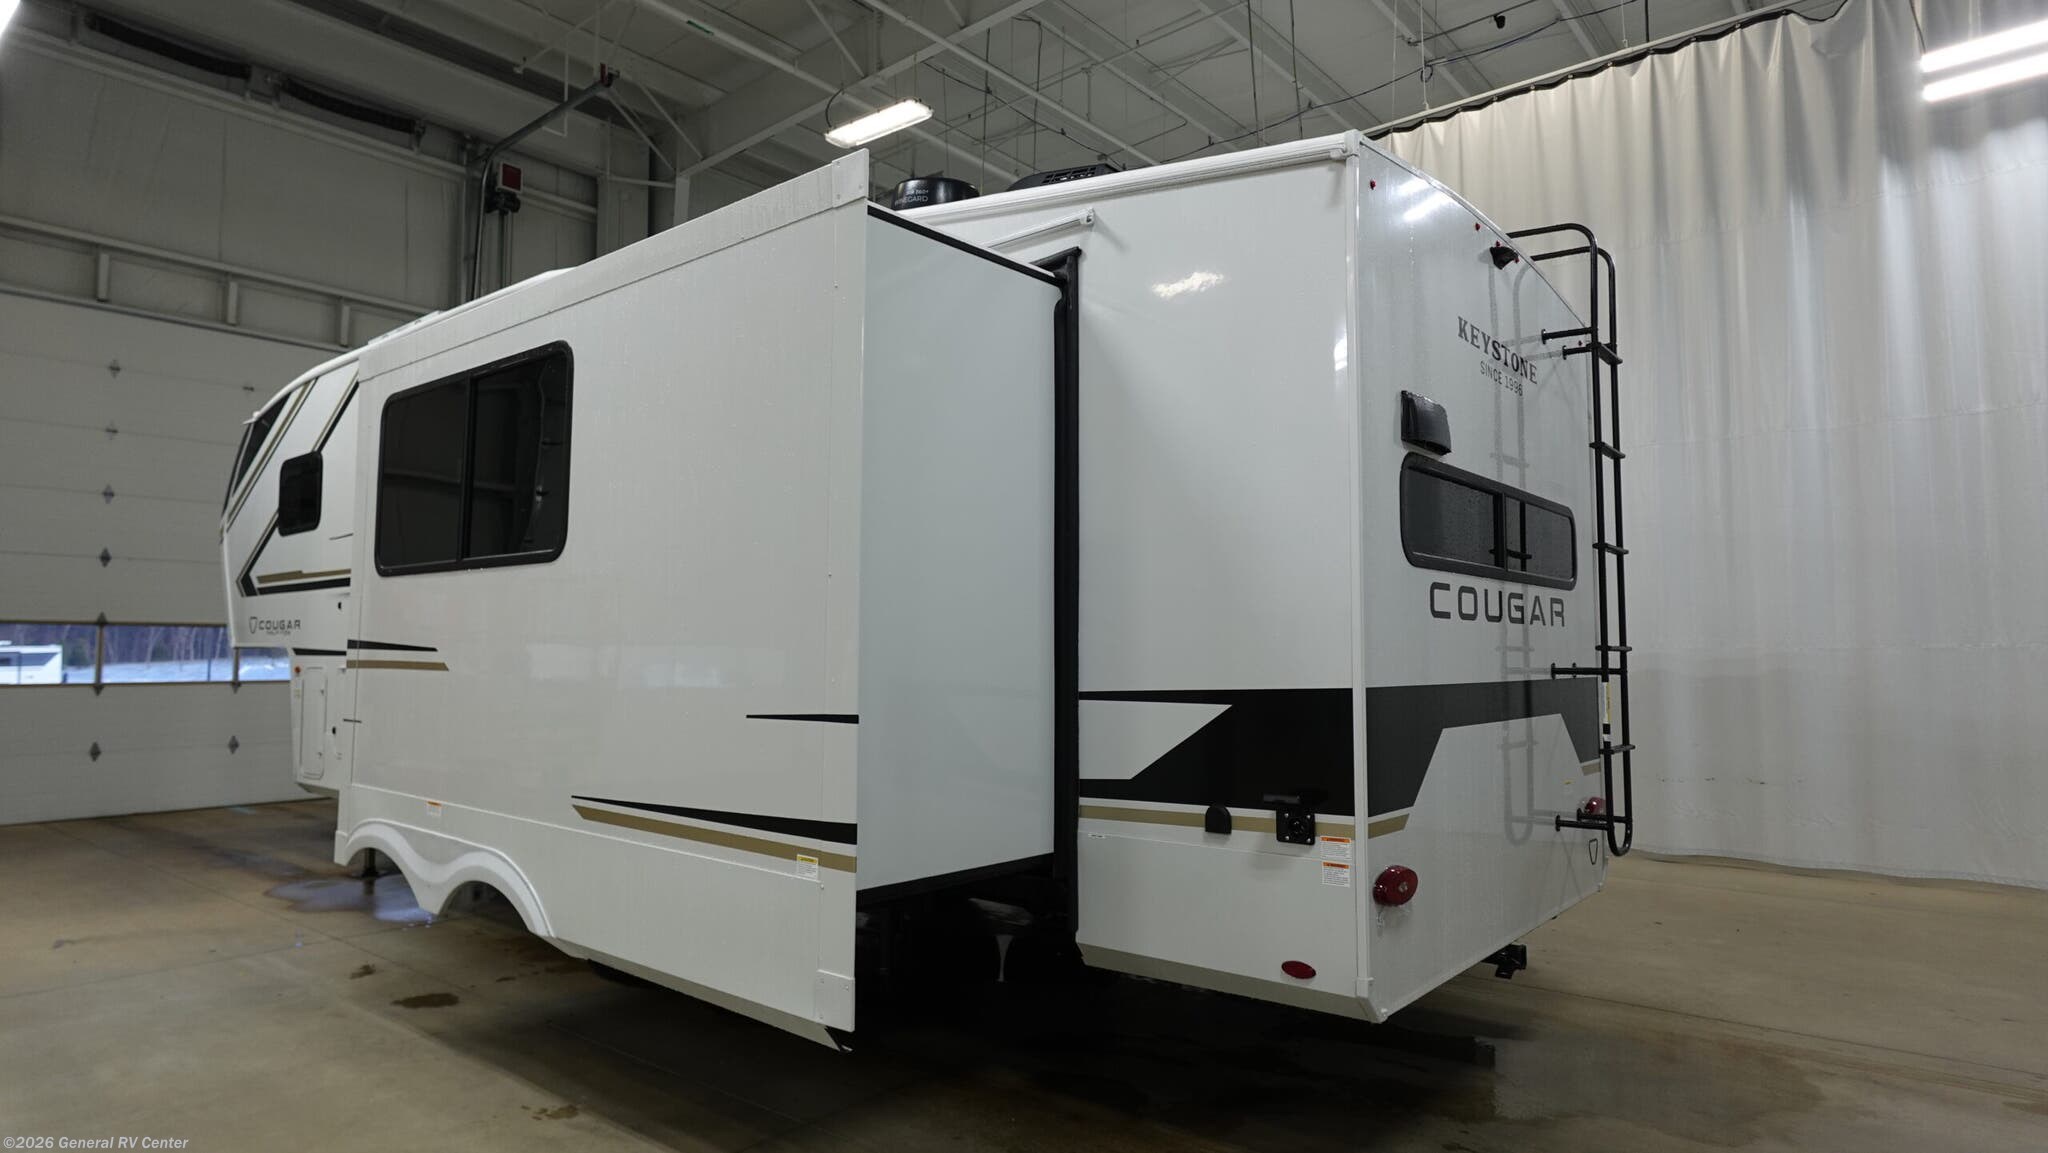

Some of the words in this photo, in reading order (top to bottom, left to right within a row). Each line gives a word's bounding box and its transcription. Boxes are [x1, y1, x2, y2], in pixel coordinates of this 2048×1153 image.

[1457, 316, 1538, 385] KEYSTONE
[1480, 360, 1503, 385] SINCE
[1429, 581, 1565, 628] COUGAR
[258, 619, 301, 630] COUGAR
